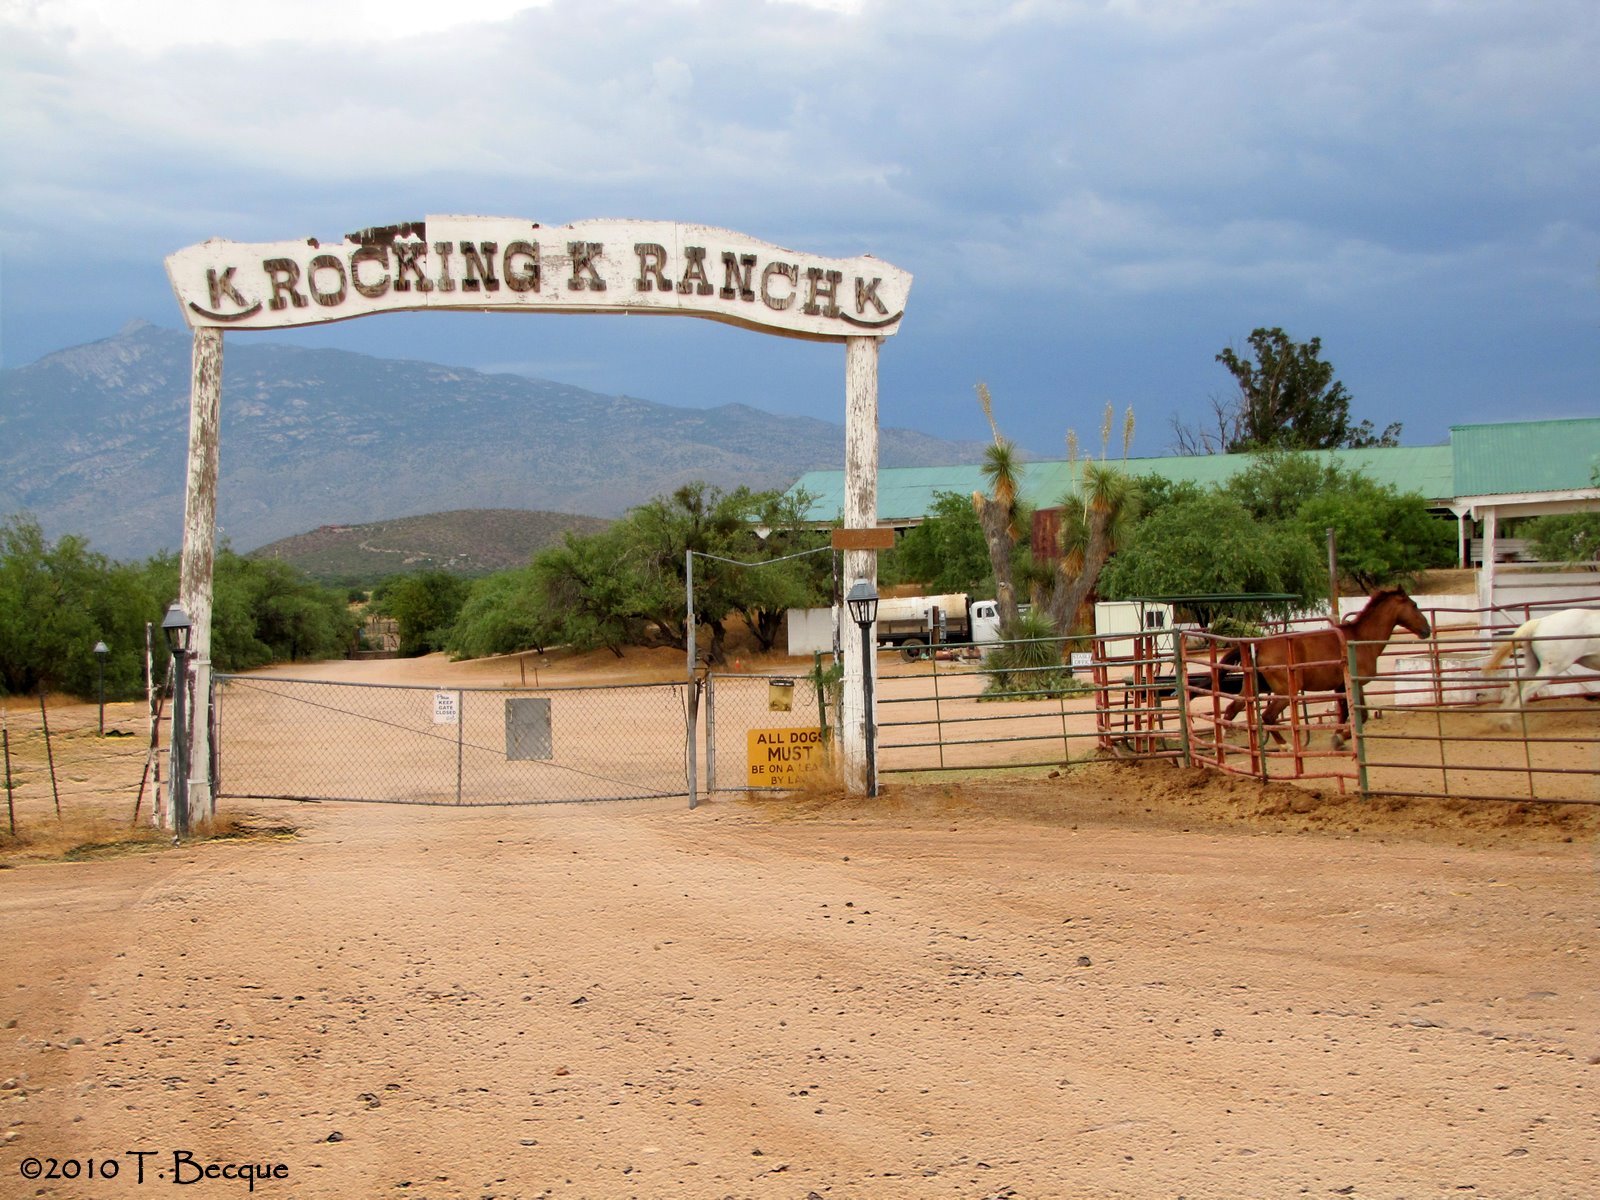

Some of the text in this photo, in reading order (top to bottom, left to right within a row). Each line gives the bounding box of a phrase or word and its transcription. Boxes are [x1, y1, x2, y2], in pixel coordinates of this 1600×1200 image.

[206, 240, 890, 319] K ROCKING K RANCH K
[757, 733, 784, 744] ALL
[768, 746, 813, 761] MUST
[751, 765, 765, 774] BE
[768, 764, 783, 773] ON
[786, 764, 794, 773] A
[771, 776, 784, 785] BY
